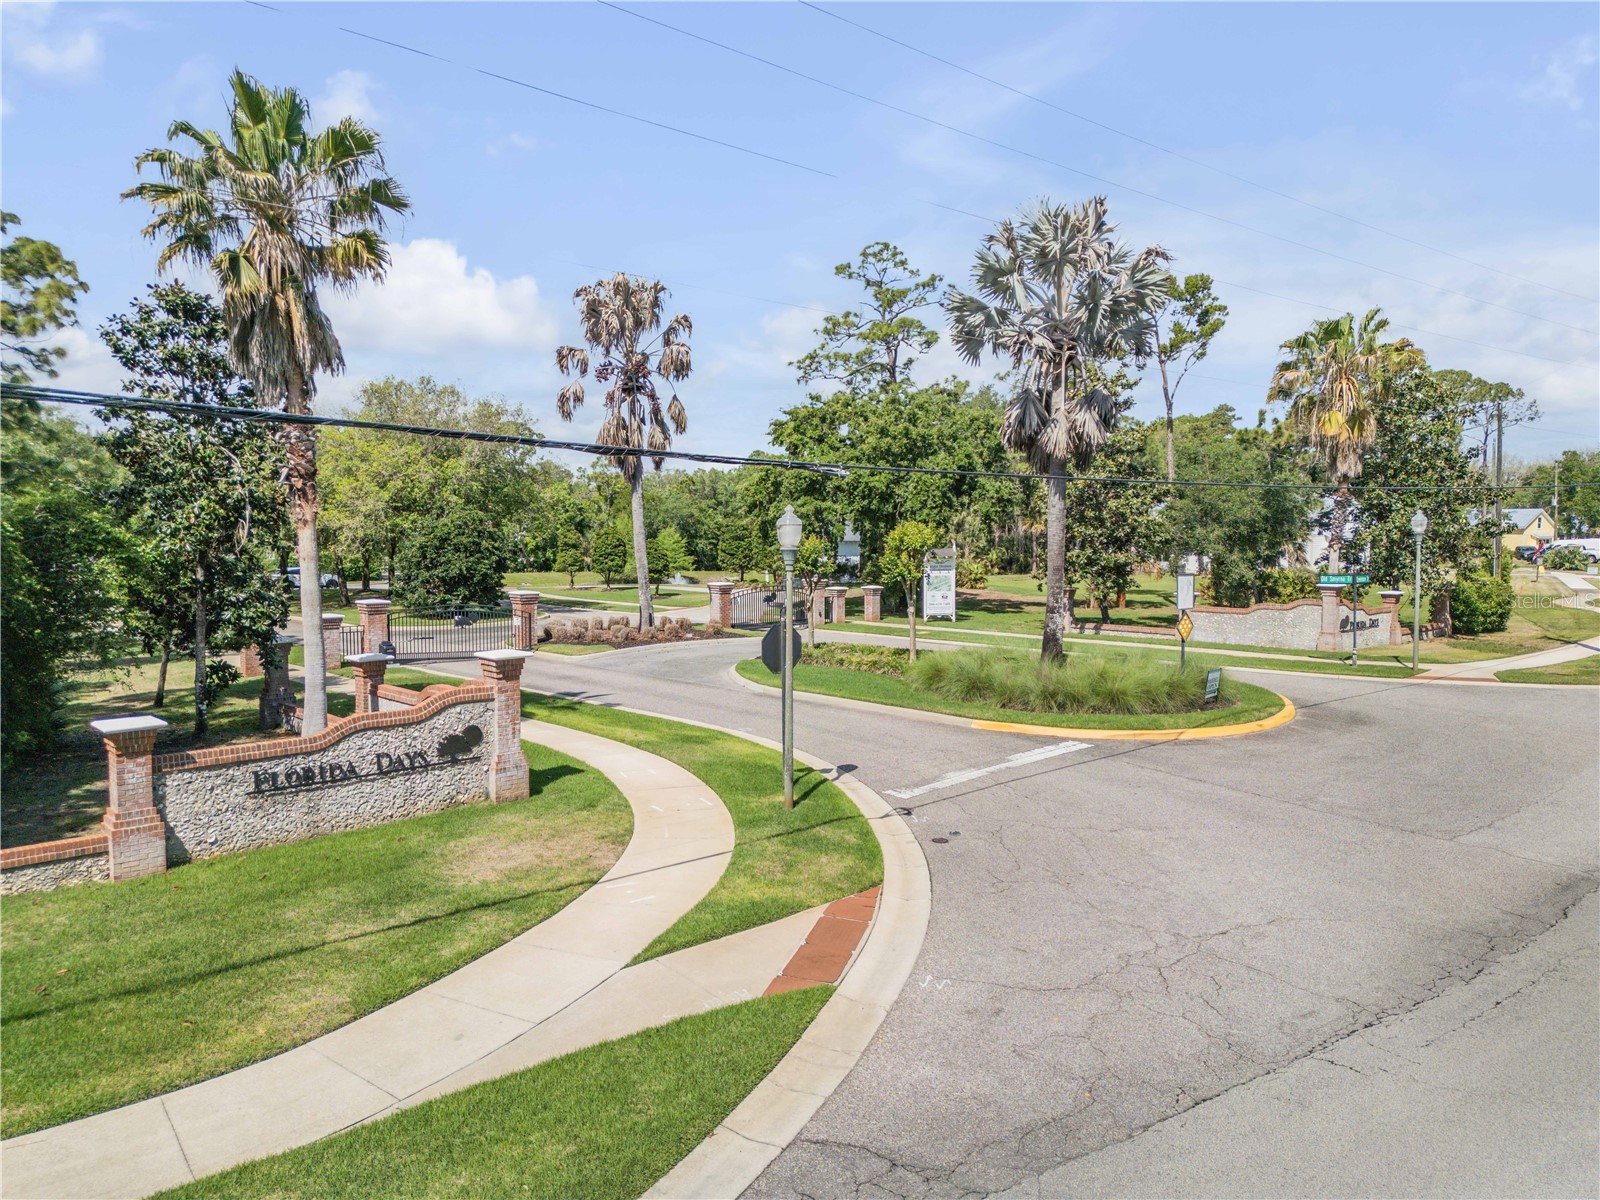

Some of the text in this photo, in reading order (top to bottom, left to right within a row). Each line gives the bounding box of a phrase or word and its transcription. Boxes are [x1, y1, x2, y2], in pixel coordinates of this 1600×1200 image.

[1320, 575, 1328, 583] Old
[252, 749, 431, 792] FLORIDA DAYS
